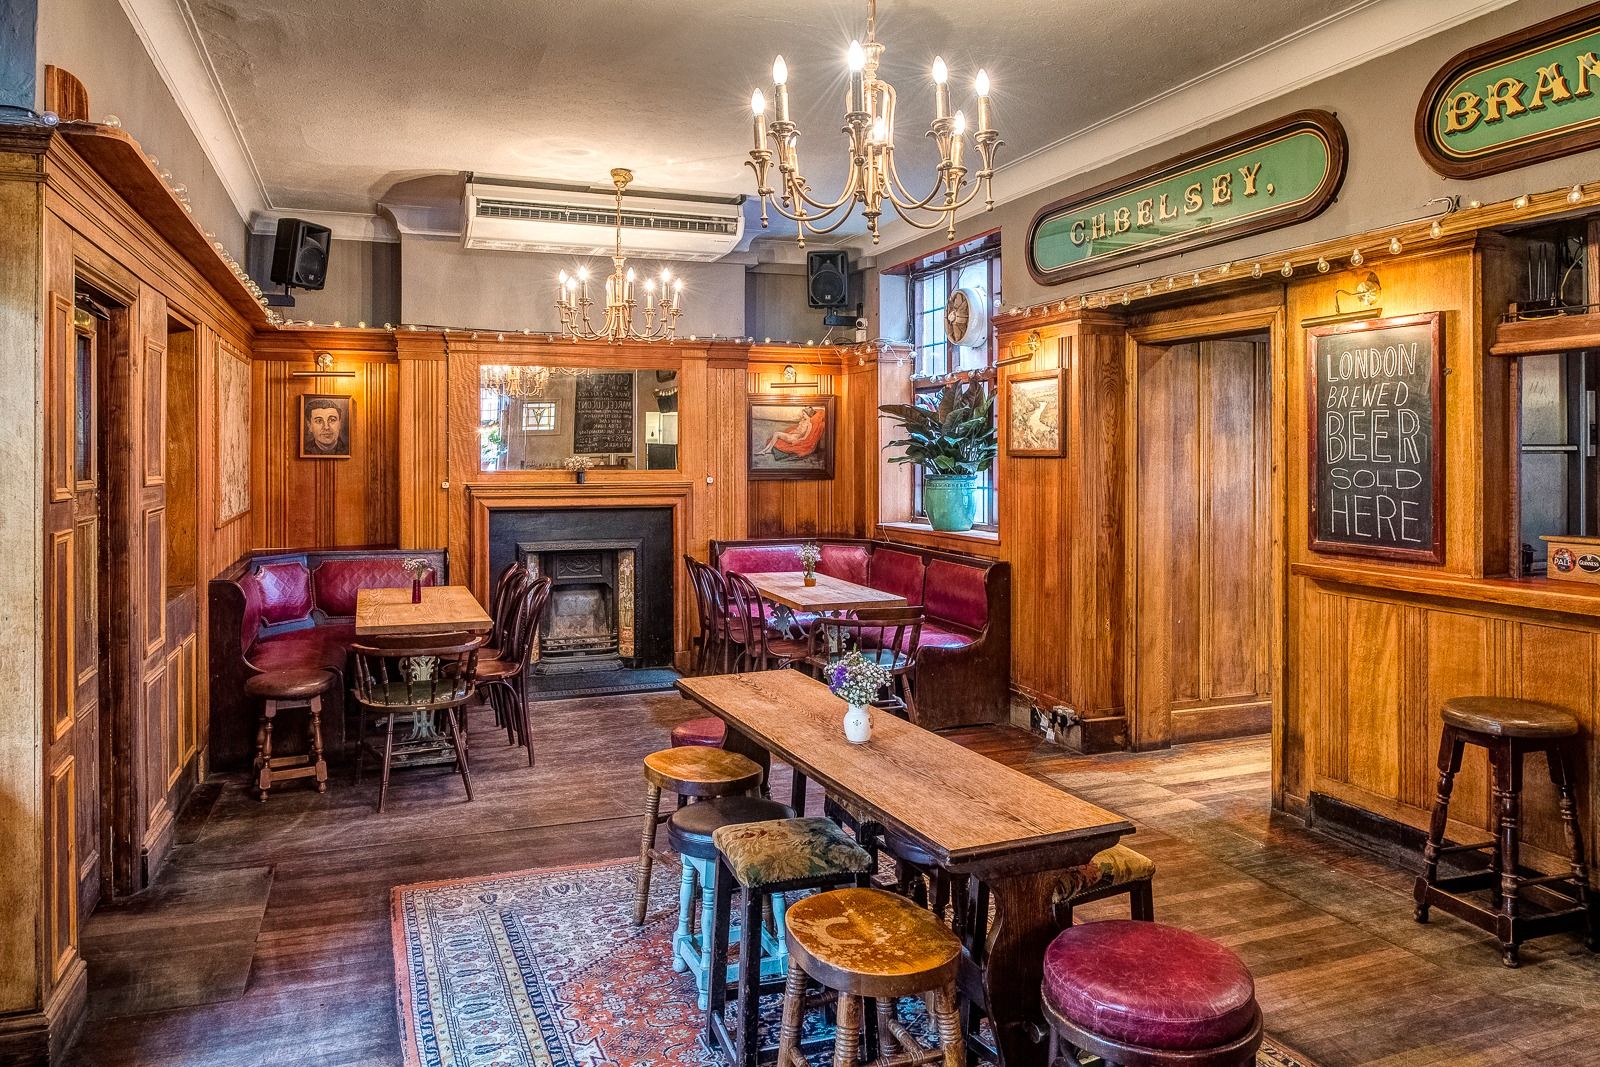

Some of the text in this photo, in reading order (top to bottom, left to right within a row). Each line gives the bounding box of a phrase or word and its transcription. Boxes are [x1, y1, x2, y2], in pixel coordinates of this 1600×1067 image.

[1326, 342, 1417, 383] LONDON
[1326, 381, 1409, 409] BREWED
[1326, 409, 1421, 464] BEER
[1330, 467, 1422, 490] SOLD
[1331, 489, 1422, 543] HERE
